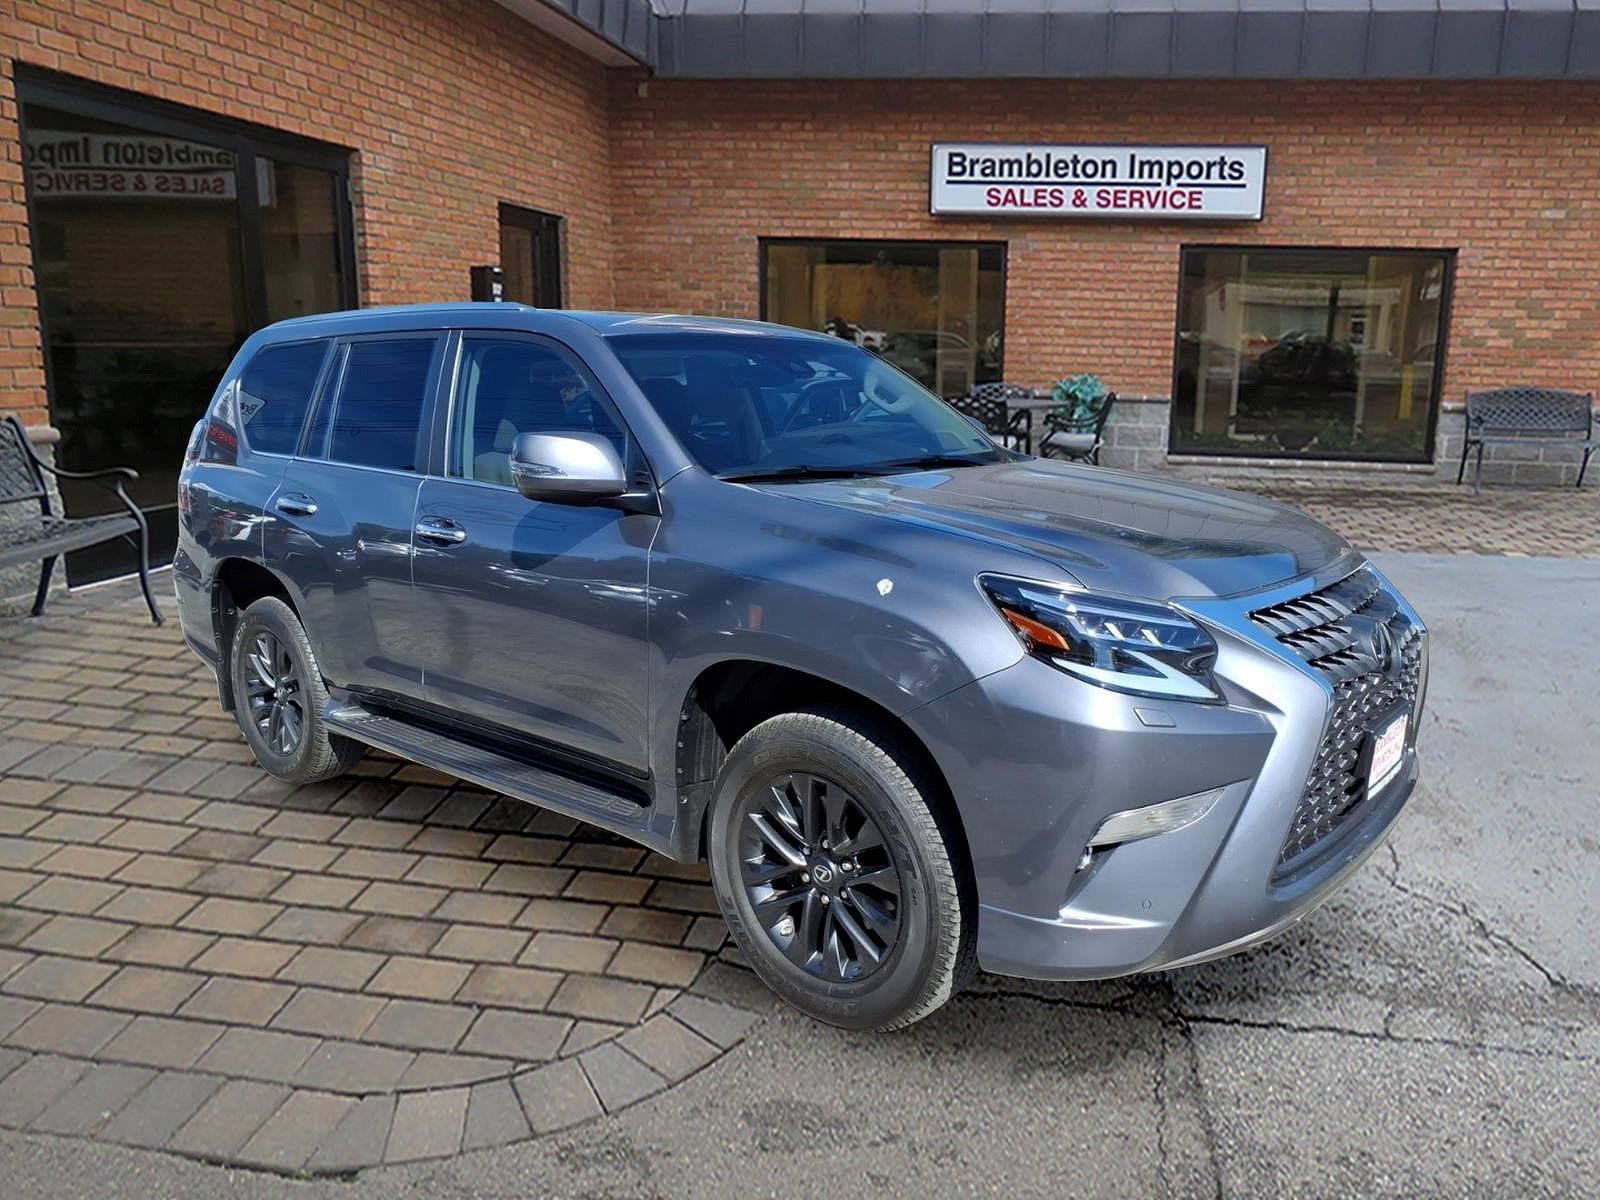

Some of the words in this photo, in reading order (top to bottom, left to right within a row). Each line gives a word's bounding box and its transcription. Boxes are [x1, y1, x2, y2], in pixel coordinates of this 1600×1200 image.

[947, 151, 1117, 179] Brambleton
[1128, 153, 1245, 186] Imports
[985, 187, 1064, 209] SALES
[1071, 188, 1088, 209] &
[1095, 188, 1204, 210] SERVICE
